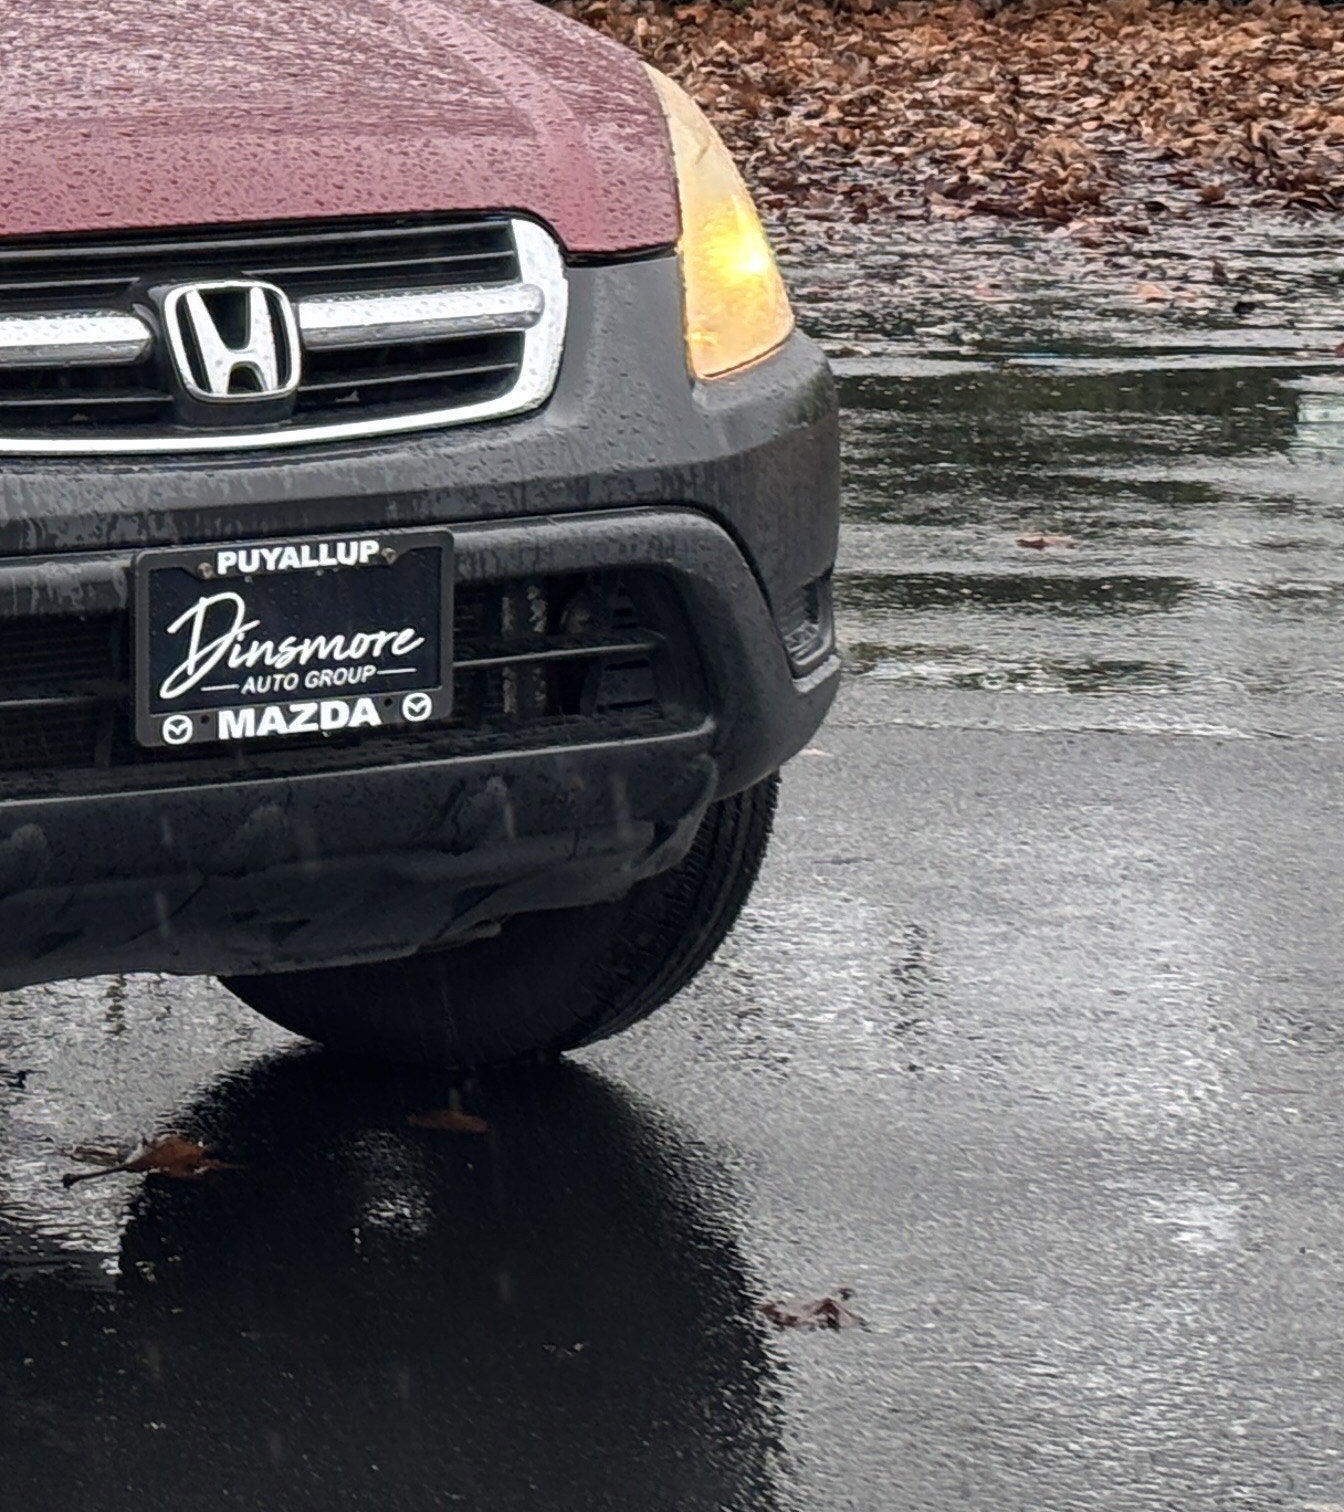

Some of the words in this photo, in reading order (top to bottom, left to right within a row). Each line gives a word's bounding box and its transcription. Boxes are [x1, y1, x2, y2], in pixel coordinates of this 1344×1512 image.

[216, 540, 379, 575] PUYALLUP
[160, 591, 425, 699] Dinsmore
[240, 672, 299, 694] AUTO
[304, 665, 377, 689] GROUP
[217, 697, 382, 739] MAZDA
